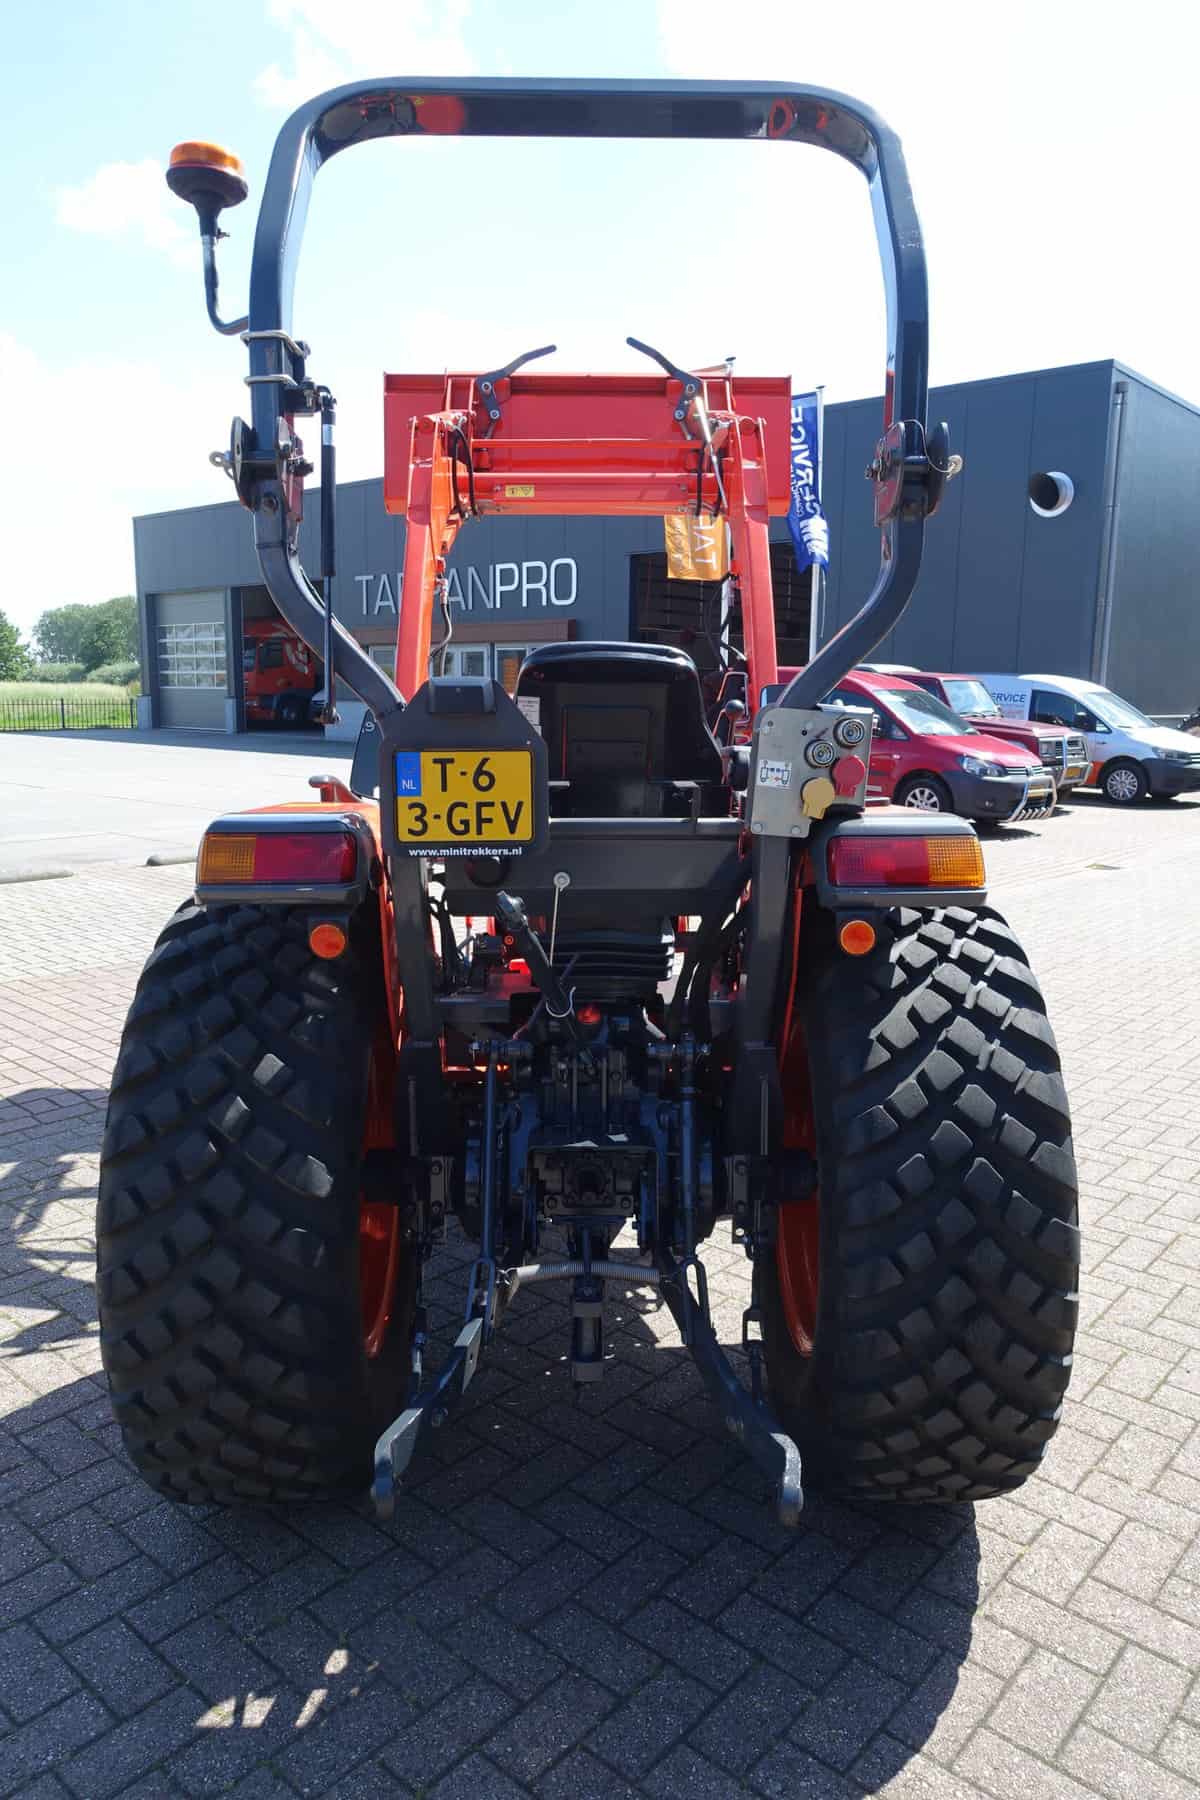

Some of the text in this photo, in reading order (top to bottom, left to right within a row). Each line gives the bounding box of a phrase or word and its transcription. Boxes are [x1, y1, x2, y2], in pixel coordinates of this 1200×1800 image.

[354, 557, 578, 616] TAANPRO
[992, 692, 1027, 703] ERVICE
[402, 779, 416, 790] NL
[432, 757, 496, 793] T-6
[407, 800, 525, 837] 3-GFV
[408, 846, 523, 857] www.minitrekkers.nl
